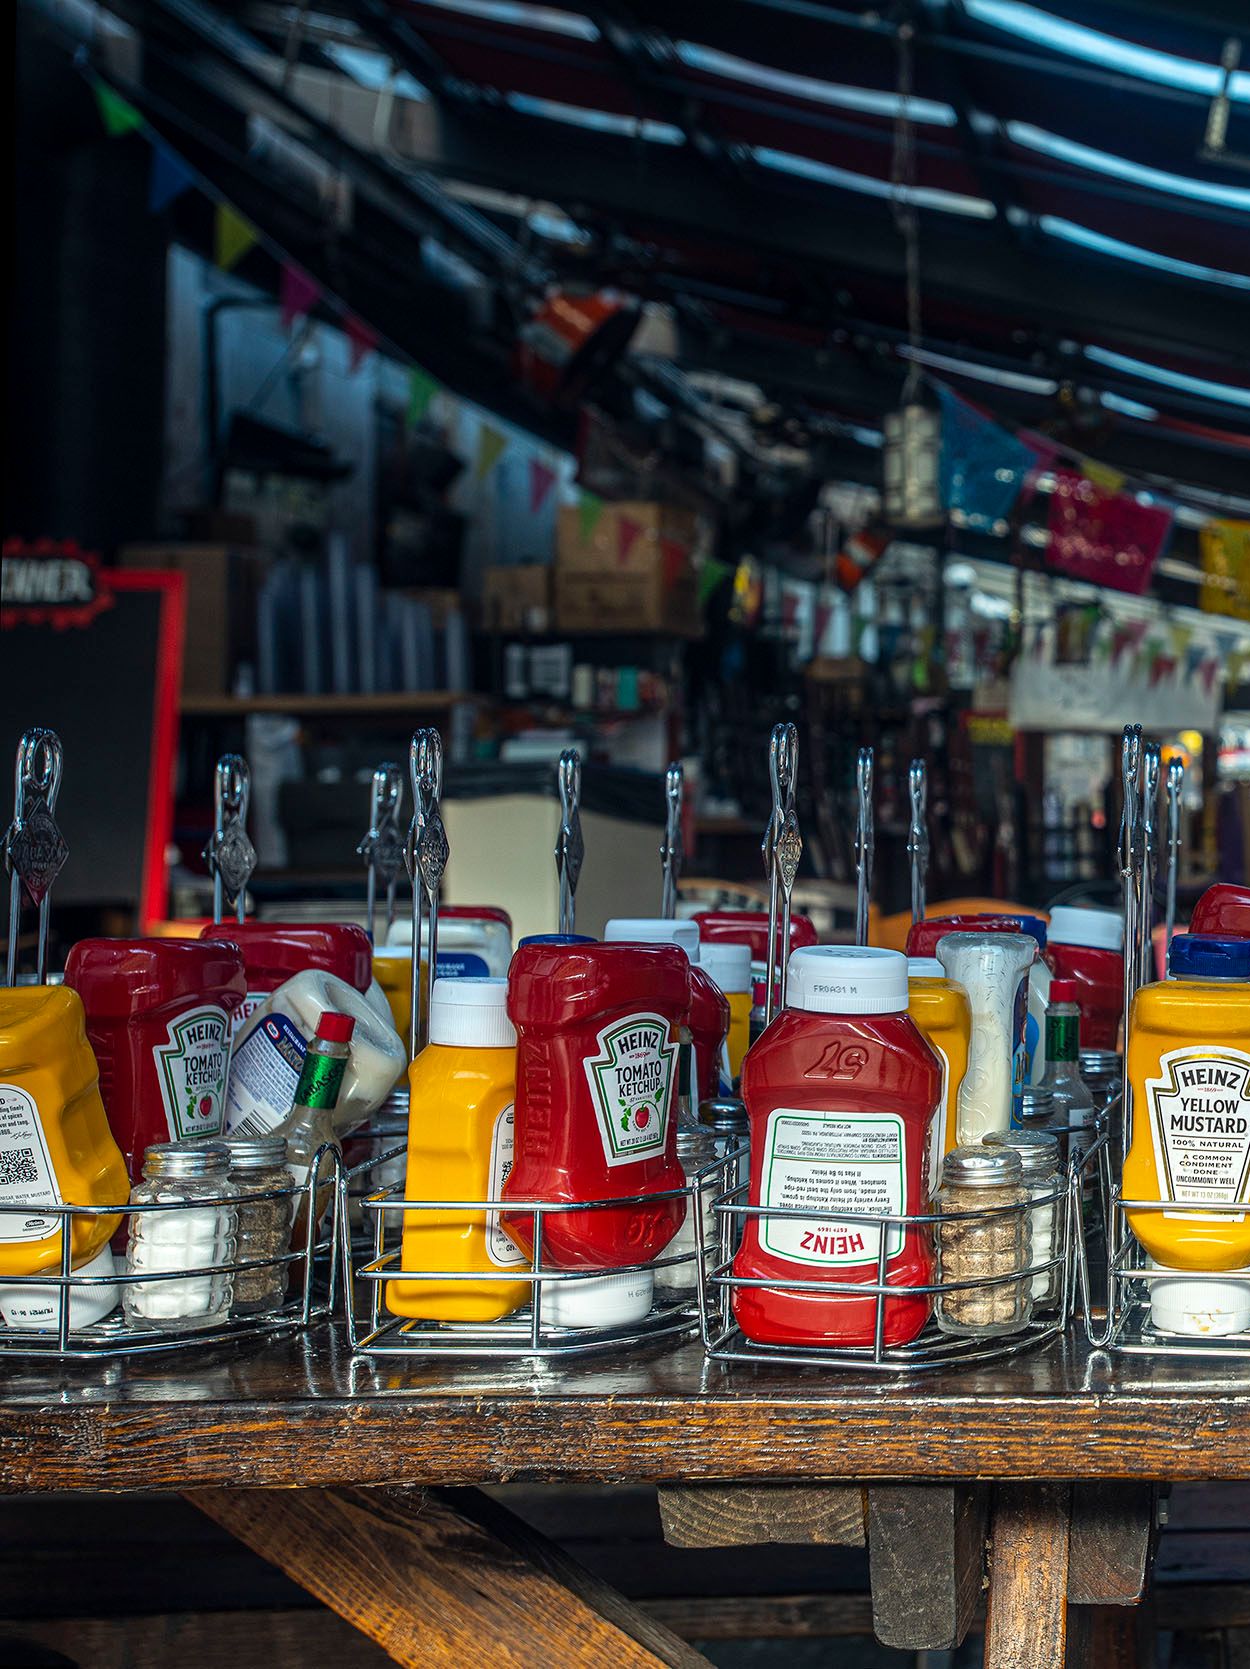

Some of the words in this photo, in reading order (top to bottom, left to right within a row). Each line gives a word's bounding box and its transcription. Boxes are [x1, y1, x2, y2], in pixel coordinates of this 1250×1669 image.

[186, 1024, 221, 1045] HEINZ
[618, 1031, 660, 1055] HEINZ
[183, 1053, 223, 1073] TOMATO
[615, 1060, 662, 1084] TOMATO
[186, 1070, 222, 1086] KETCHUP
[1181, 1068, 1241, 1090] HEINZ
[619, 1079, 660, 1098] KETCHUP
[525, 1041, 551, 1158] HEINZ
[1181, 1098, 1240, 1115] YELLOW
[1170, 1115, 1248, 1134] MUSTARD
[1172, 1139, 1196, 1148] 100%
[1200, 1141, 1244, 1149] NATURAL
[1179, 1161, 1233, 1169] CONDIMENT
[1176, 1176, 1218, 1185] UNCOMMONLY
[1219, 1178, 1235, 1186] WELL
[1182, 1190, 1190, 1198] NET
[1191, 1190, 1199, 1198] WT
[800, 1231, 864, 1255] HEINZ
